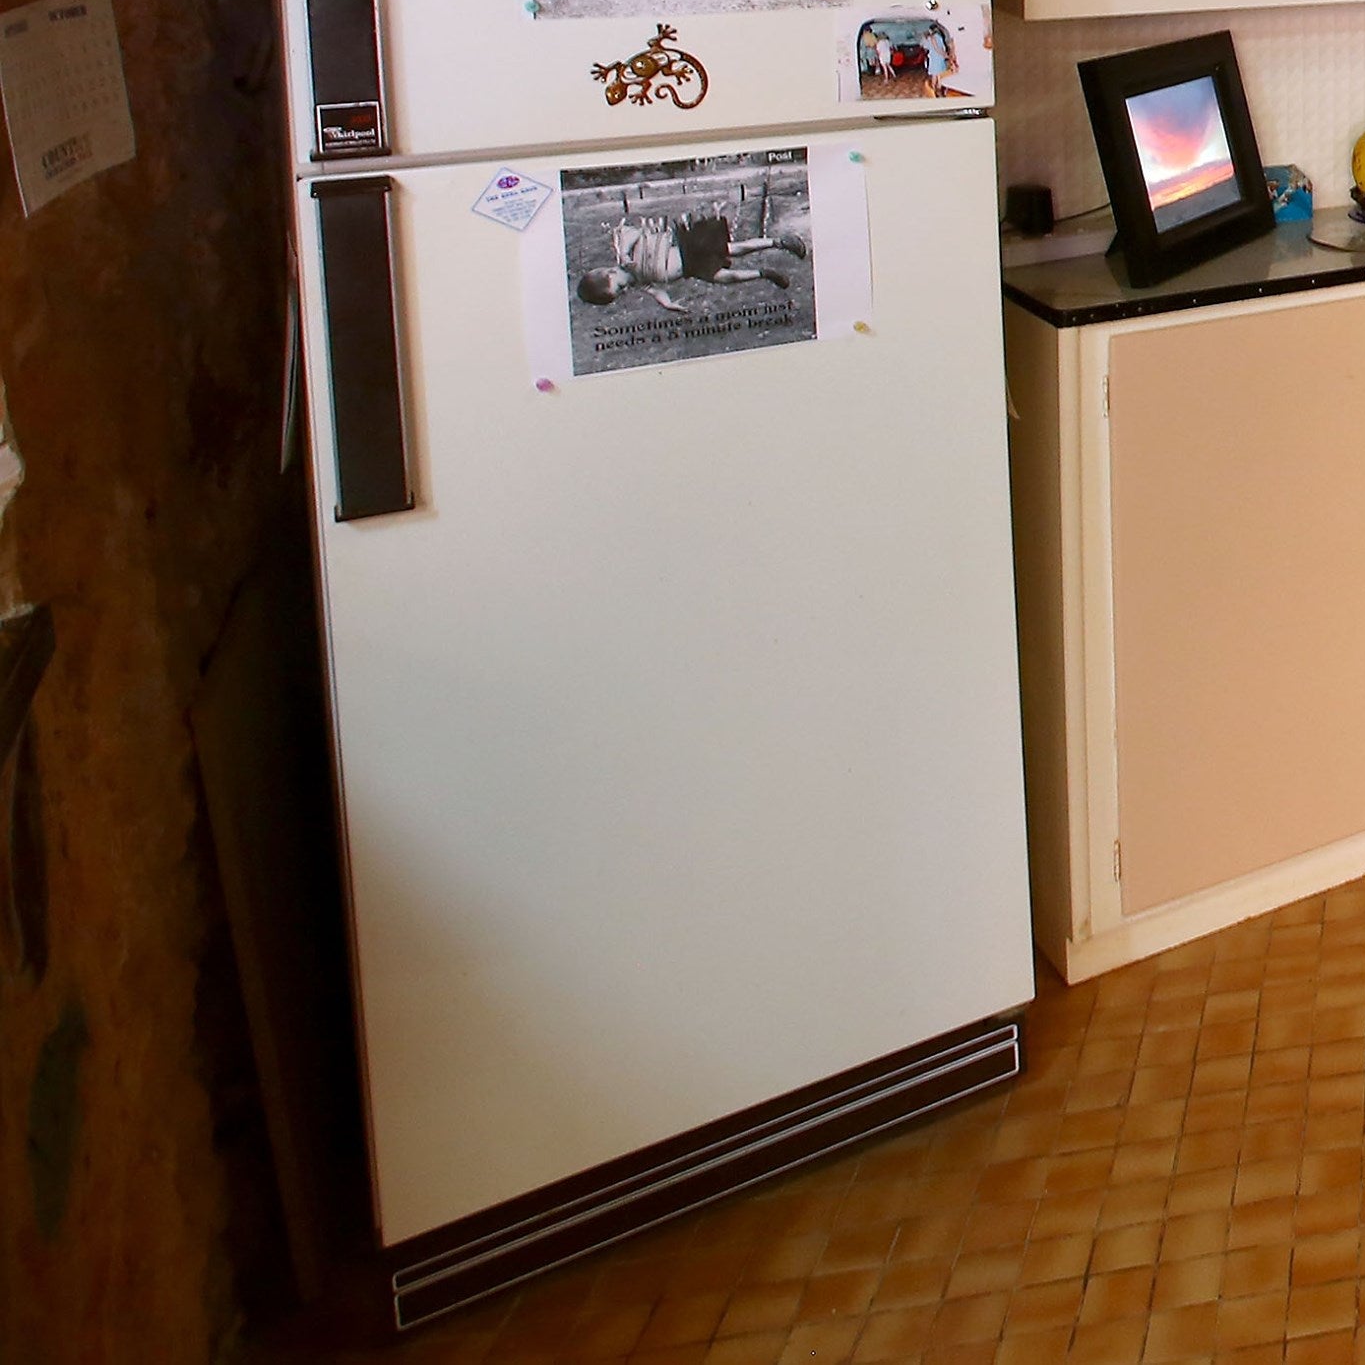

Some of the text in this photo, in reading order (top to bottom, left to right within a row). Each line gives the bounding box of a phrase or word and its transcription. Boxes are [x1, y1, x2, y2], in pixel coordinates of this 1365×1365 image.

[768, 150, 793, 163] Post
[594, 316, 694, 339] Sometimes
[716, 307, 758, 322] mom
[764, 300, 793, 317] just
[595, 336, 646, 352] needs
[684, 321, 741, 338] minute
[747, 314, 794, 330] break
